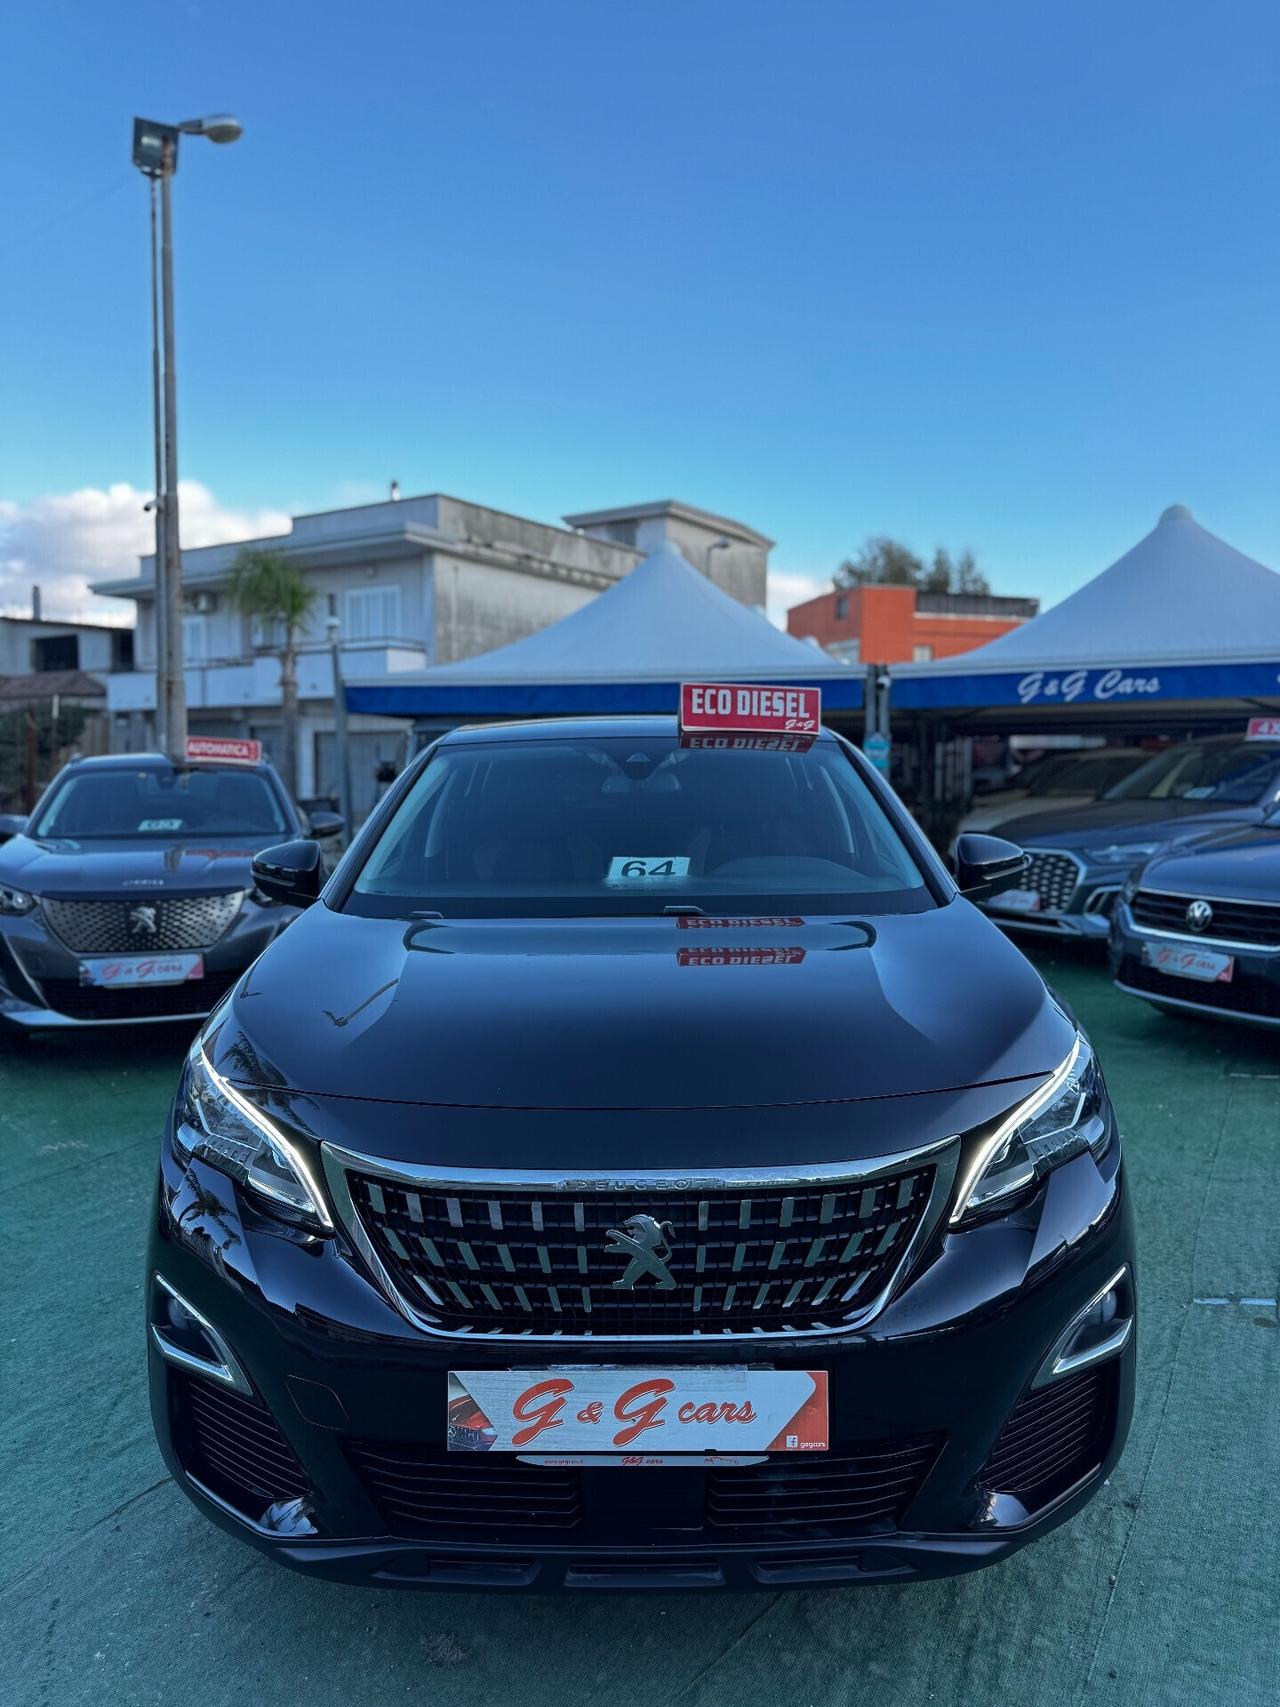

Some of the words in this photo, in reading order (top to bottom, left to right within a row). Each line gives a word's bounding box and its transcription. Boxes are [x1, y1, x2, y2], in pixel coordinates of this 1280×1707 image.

[1094, 669, 1160, 699] Cars
[691, 688, 732, 715] ECO
[736, 689, 810, 718] DIESEL
[187, 741, 249, 756] AUTOMATICA
[621, 860, 676, 877] 64
[677, 1399, 758, 1425] cars
[621, 1456, 643, 1466] G&G
